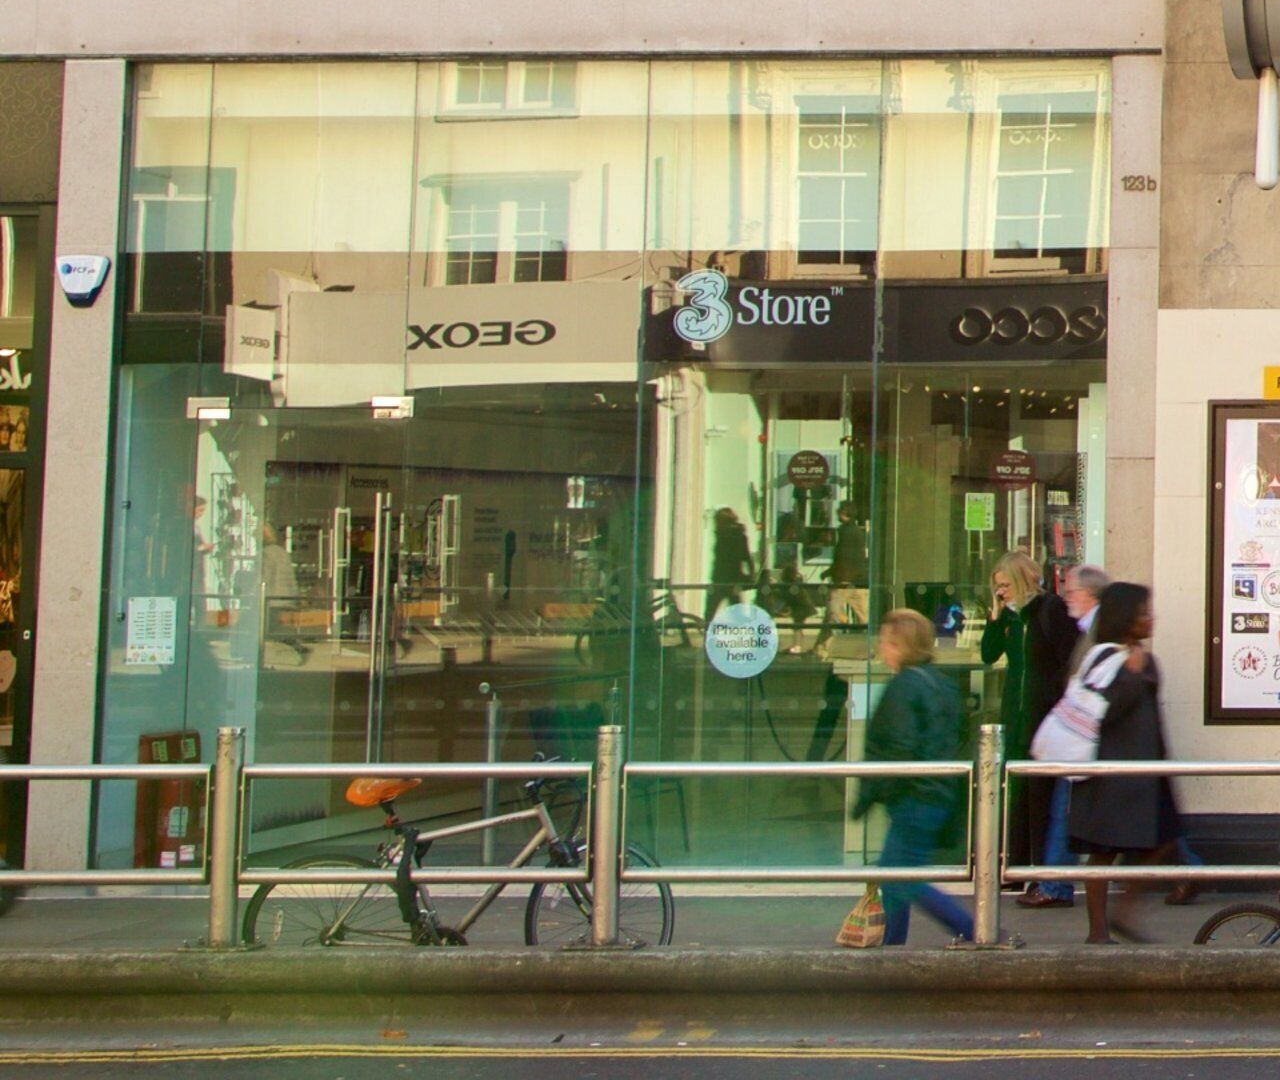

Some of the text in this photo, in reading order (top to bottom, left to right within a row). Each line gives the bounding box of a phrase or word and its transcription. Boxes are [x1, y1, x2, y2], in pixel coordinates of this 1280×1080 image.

[736, 286, 831, 326] Store
[712, 623, 772, 636] iPhone 6s
[715, 637, 769, 649] available
